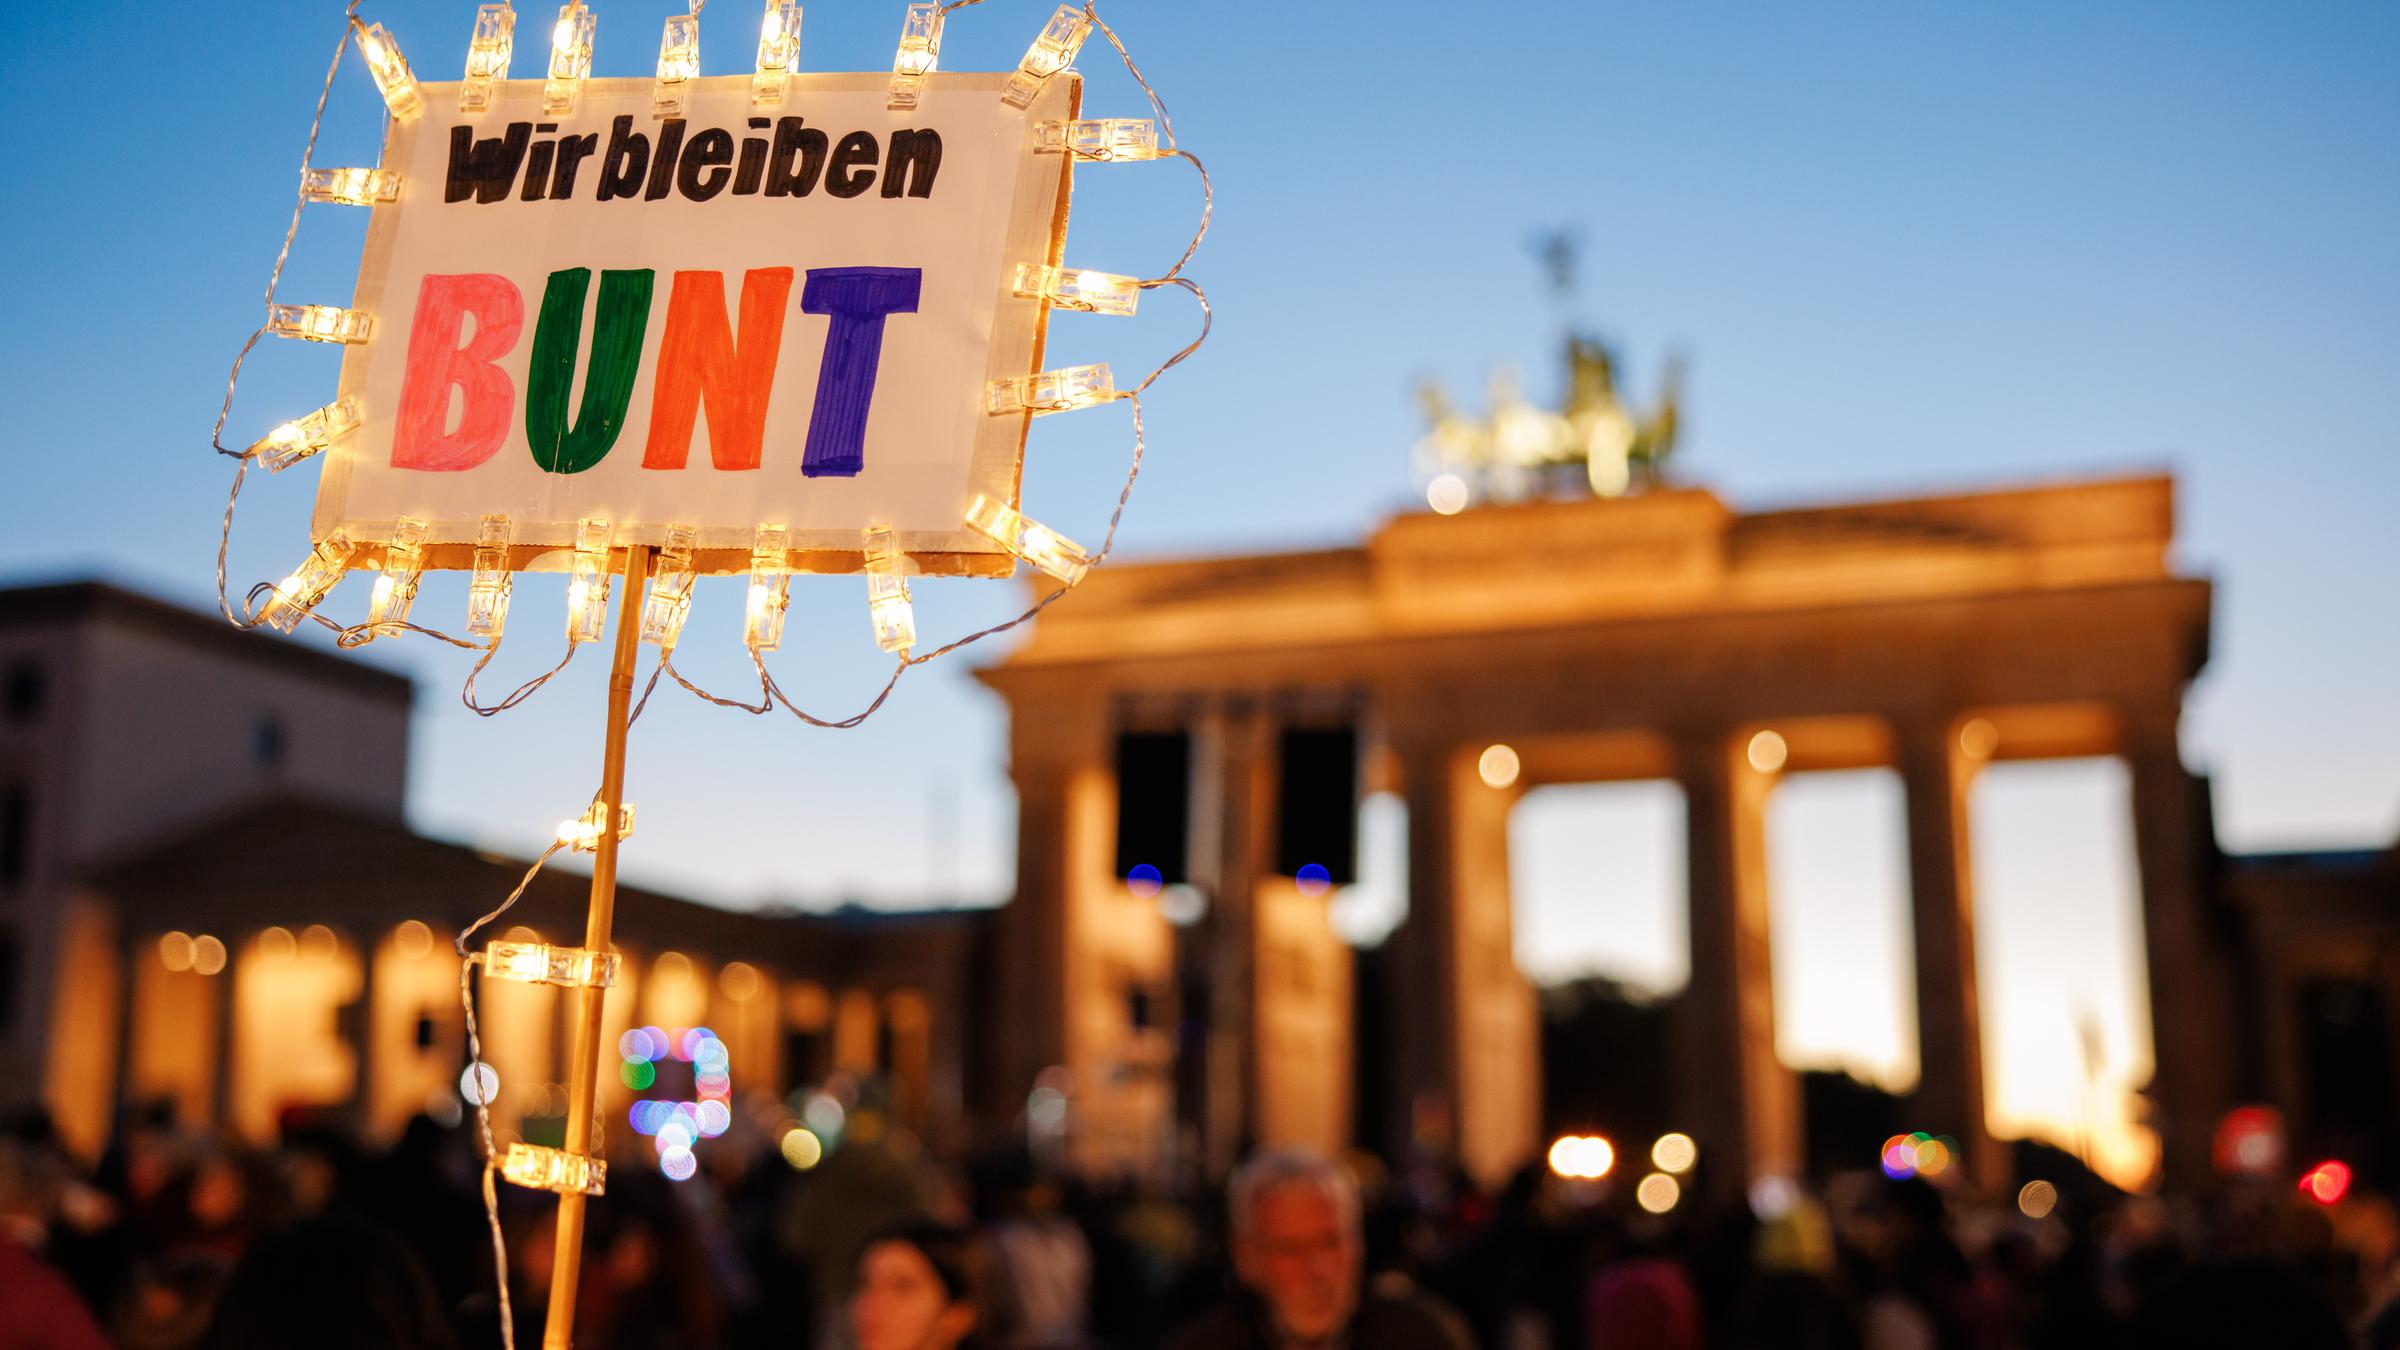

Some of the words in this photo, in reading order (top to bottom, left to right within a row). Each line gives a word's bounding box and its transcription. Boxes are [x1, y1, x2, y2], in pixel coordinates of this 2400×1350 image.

[444, 121, 600, 204] Wir
[596, 115, 943, 202] bleiben
[390, 266, 923, 478] BUNT
